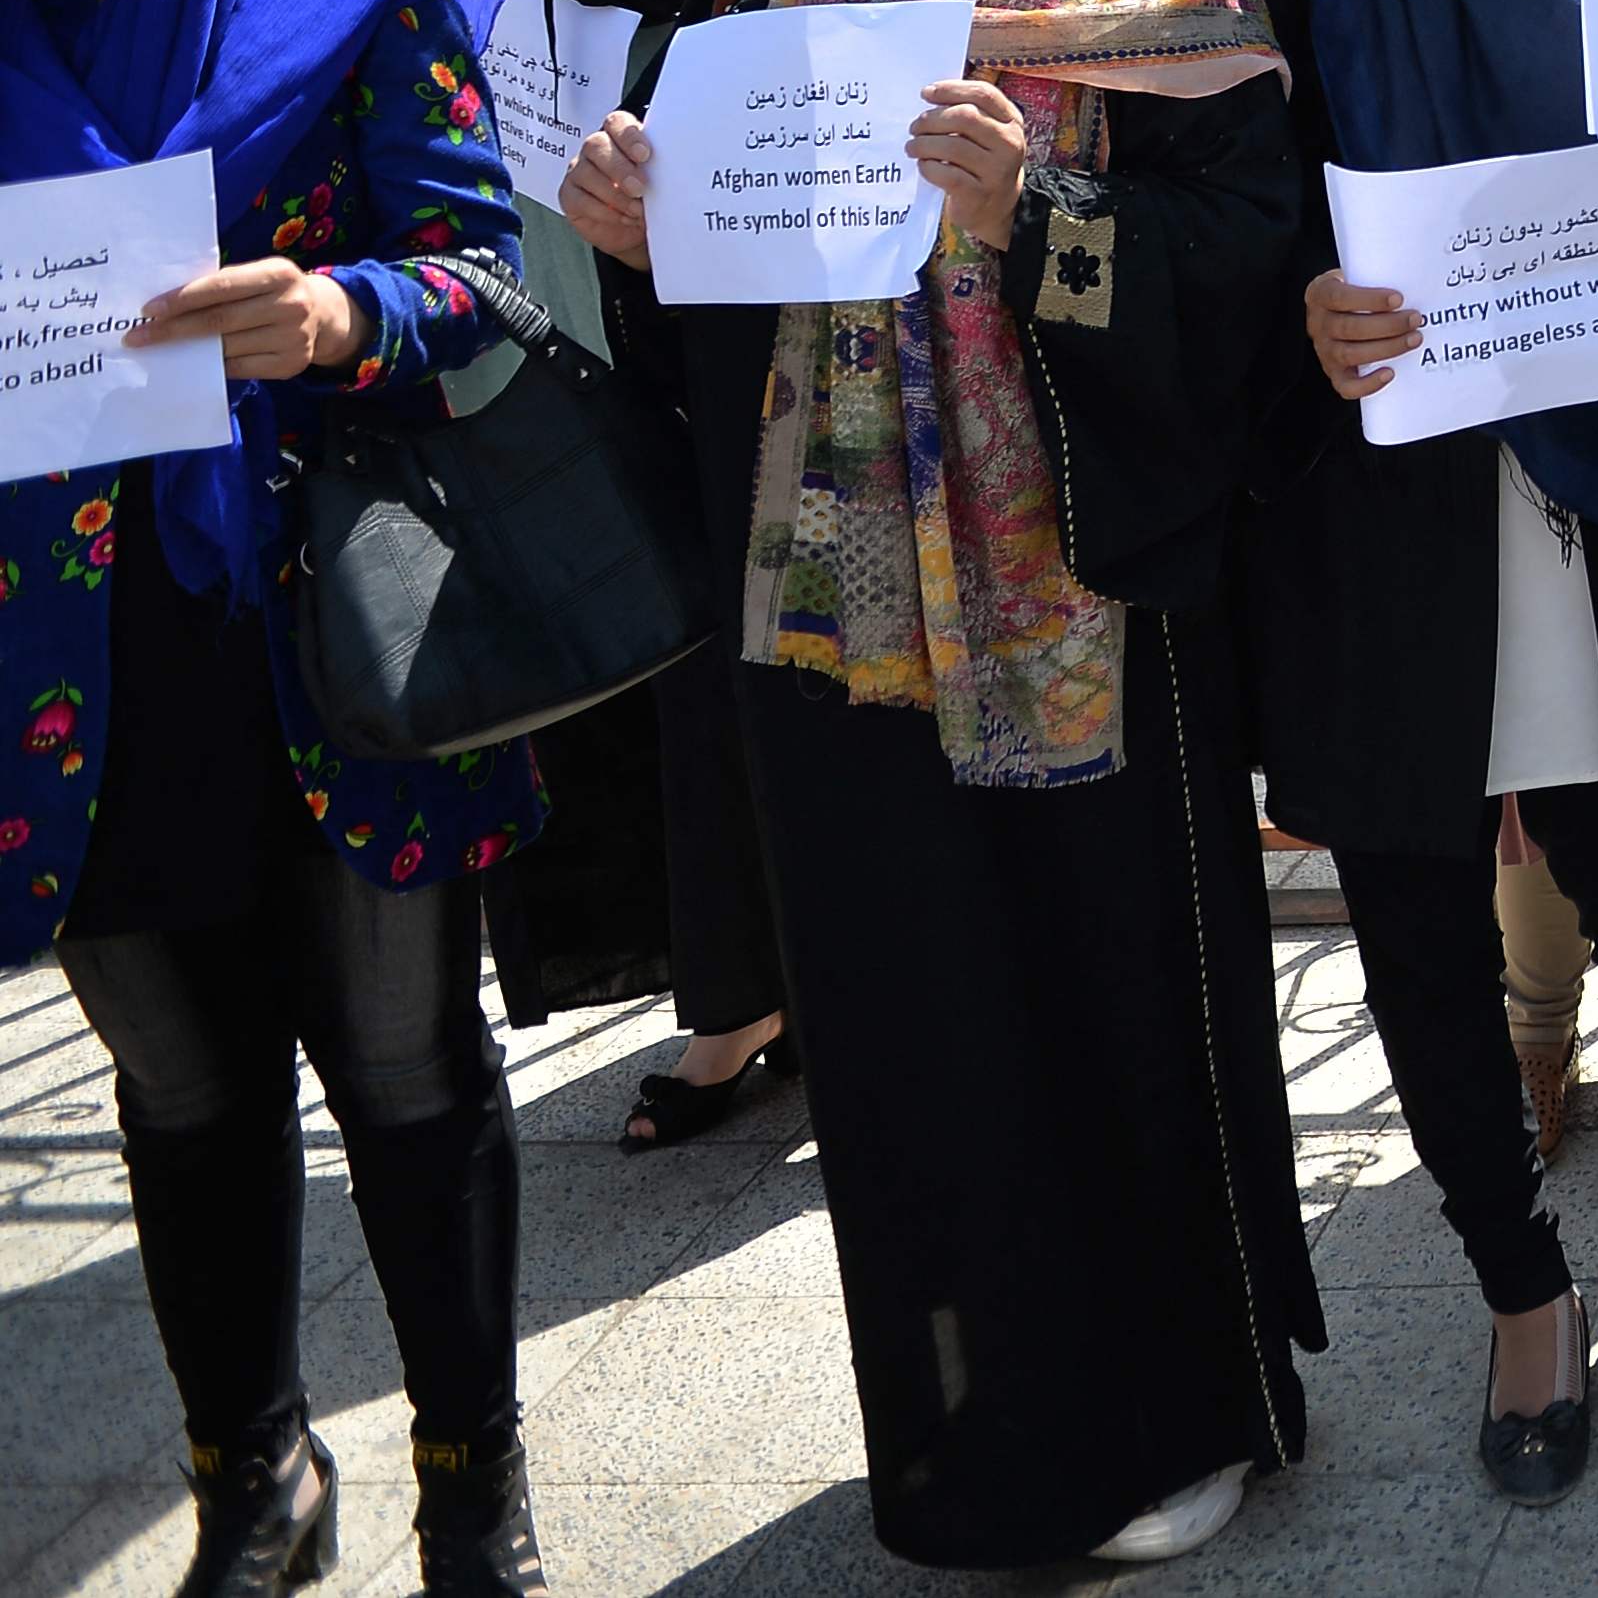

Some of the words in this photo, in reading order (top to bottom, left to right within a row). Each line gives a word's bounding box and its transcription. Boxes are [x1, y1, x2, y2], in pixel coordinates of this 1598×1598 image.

[745, 86, 788, 111] زمین
[791, 79, 830, 108] افغان
[834, 81, 868, 106] زنان
[494, 92, 501, 103] n
[503, 96, 533, 119] which
[537, 112, 581, 138] women
[500, 120, 524, 139] ctive
[526, 130, 534, 145] is
[537, 136, 565, 157] dead
[745, 125, 810, 150] سرزمین
[812, 123, 836, 147] این
[841, 121, 871, 141] نماد
[502, 145, 526, 168] ciety
[710, 167, 779, 194] Afghan
[783, 169, 852, 187] women
[855, 161, 902, 184] Earth
[703, 209, 739, 232] The
[742, 206, 812, 235] symbol
[816, 205, 837, 228] of
[839, 204, 871, 228] this
[874, 203, 912, 227] land
[1498, 221, 1544, 244] بدون
[1548, 208, 1598, 236] کشور
[1451, 226, 1493, 253] زنان
[32, 248, 109, 280] تحصیل
[1491, 260, 1517, 282] بی
[1523, 249, 1546, 275] ای
[1445, 263, 1490, 290] زبان
[16, 295, 40, 313] به
[48, 287, 99, 310] پیش
[1418, 301, 1489, 329] ountry
[1494, 279, 1584, 313] without
[1420, 347, 1438, 367] A
[1443, 319, 1587, 363] languageless
[29, 349, 104, 385] abadi
